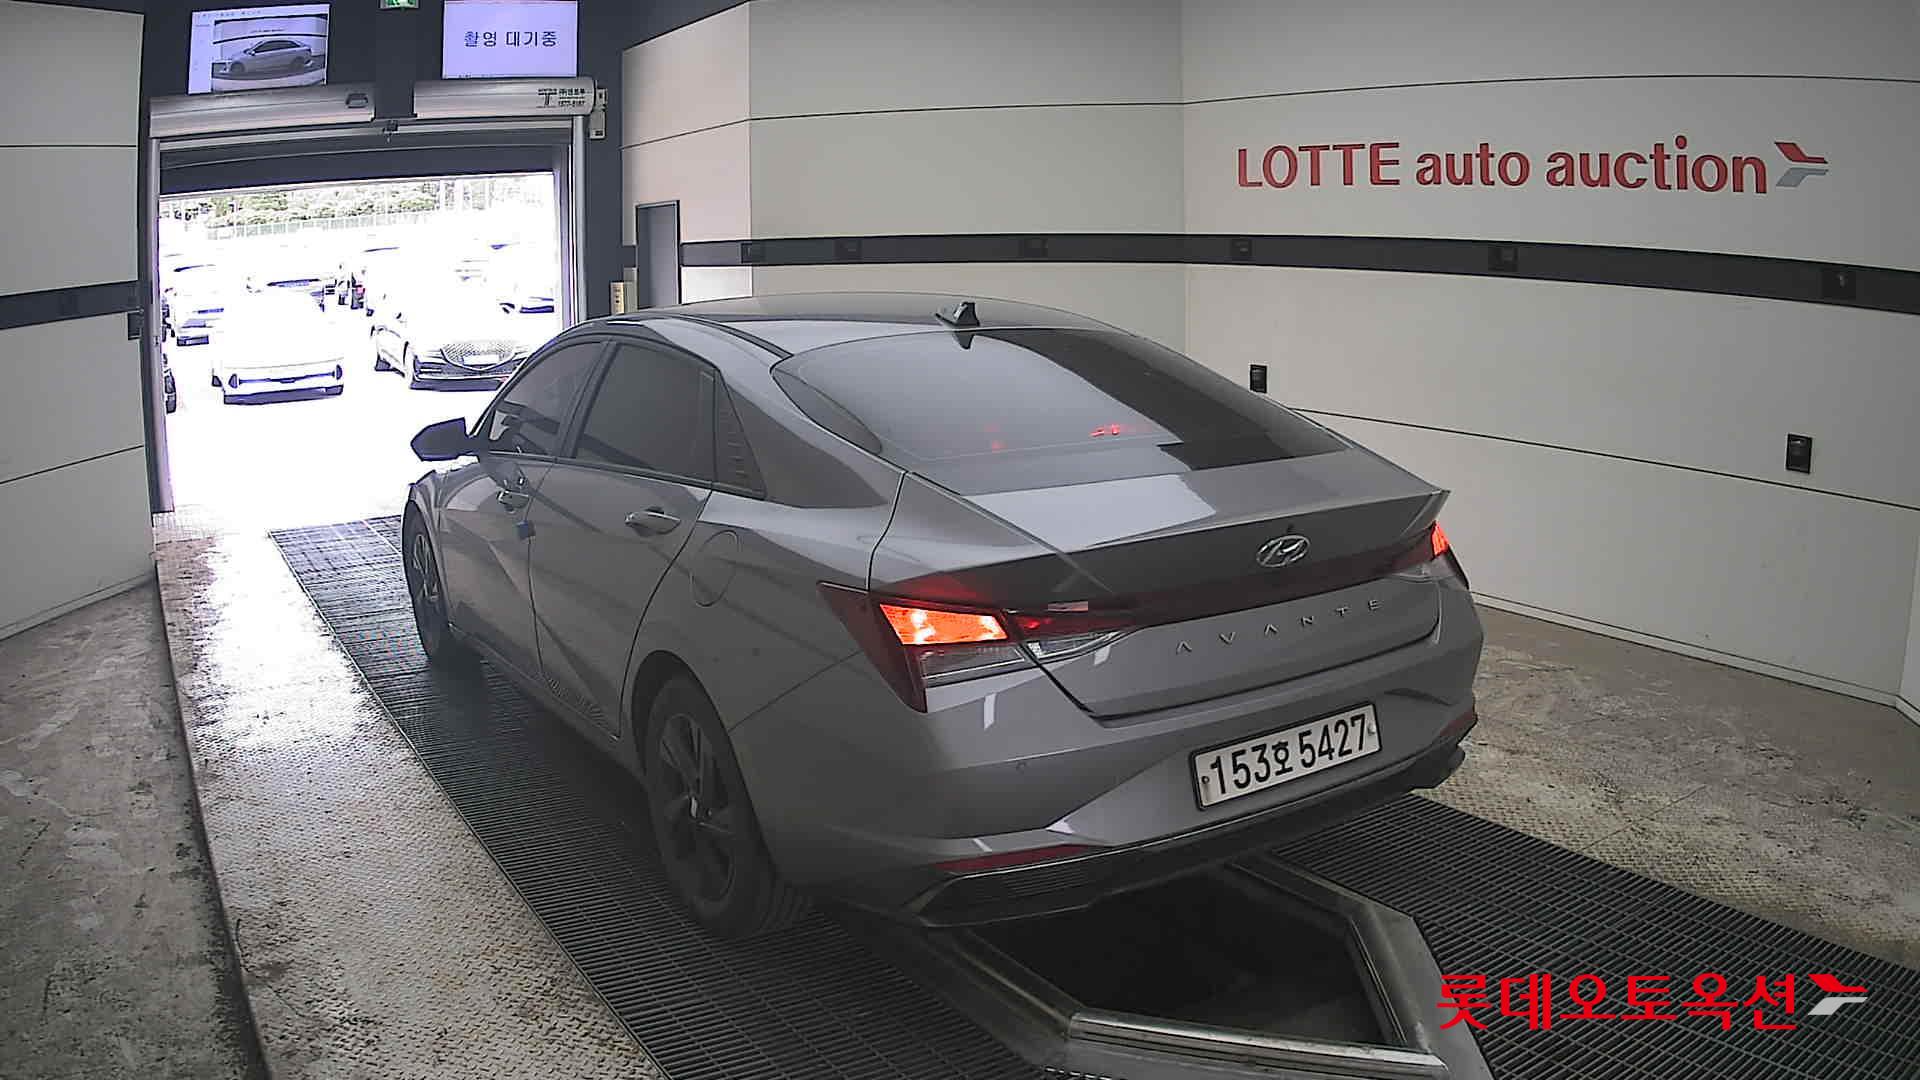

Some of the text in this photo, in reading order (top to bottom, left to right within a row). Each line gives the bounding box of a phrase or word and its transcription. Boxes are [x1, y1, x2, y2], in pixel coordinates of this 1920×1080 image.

[464, 31, 557, 48] 촬영 대기중
[1238, 135, 1767, 194] LOTTE auto auction
[1175, 599, 1382, 655] AVANTE
[1210, 714, 1366, 794] 153호 5427
